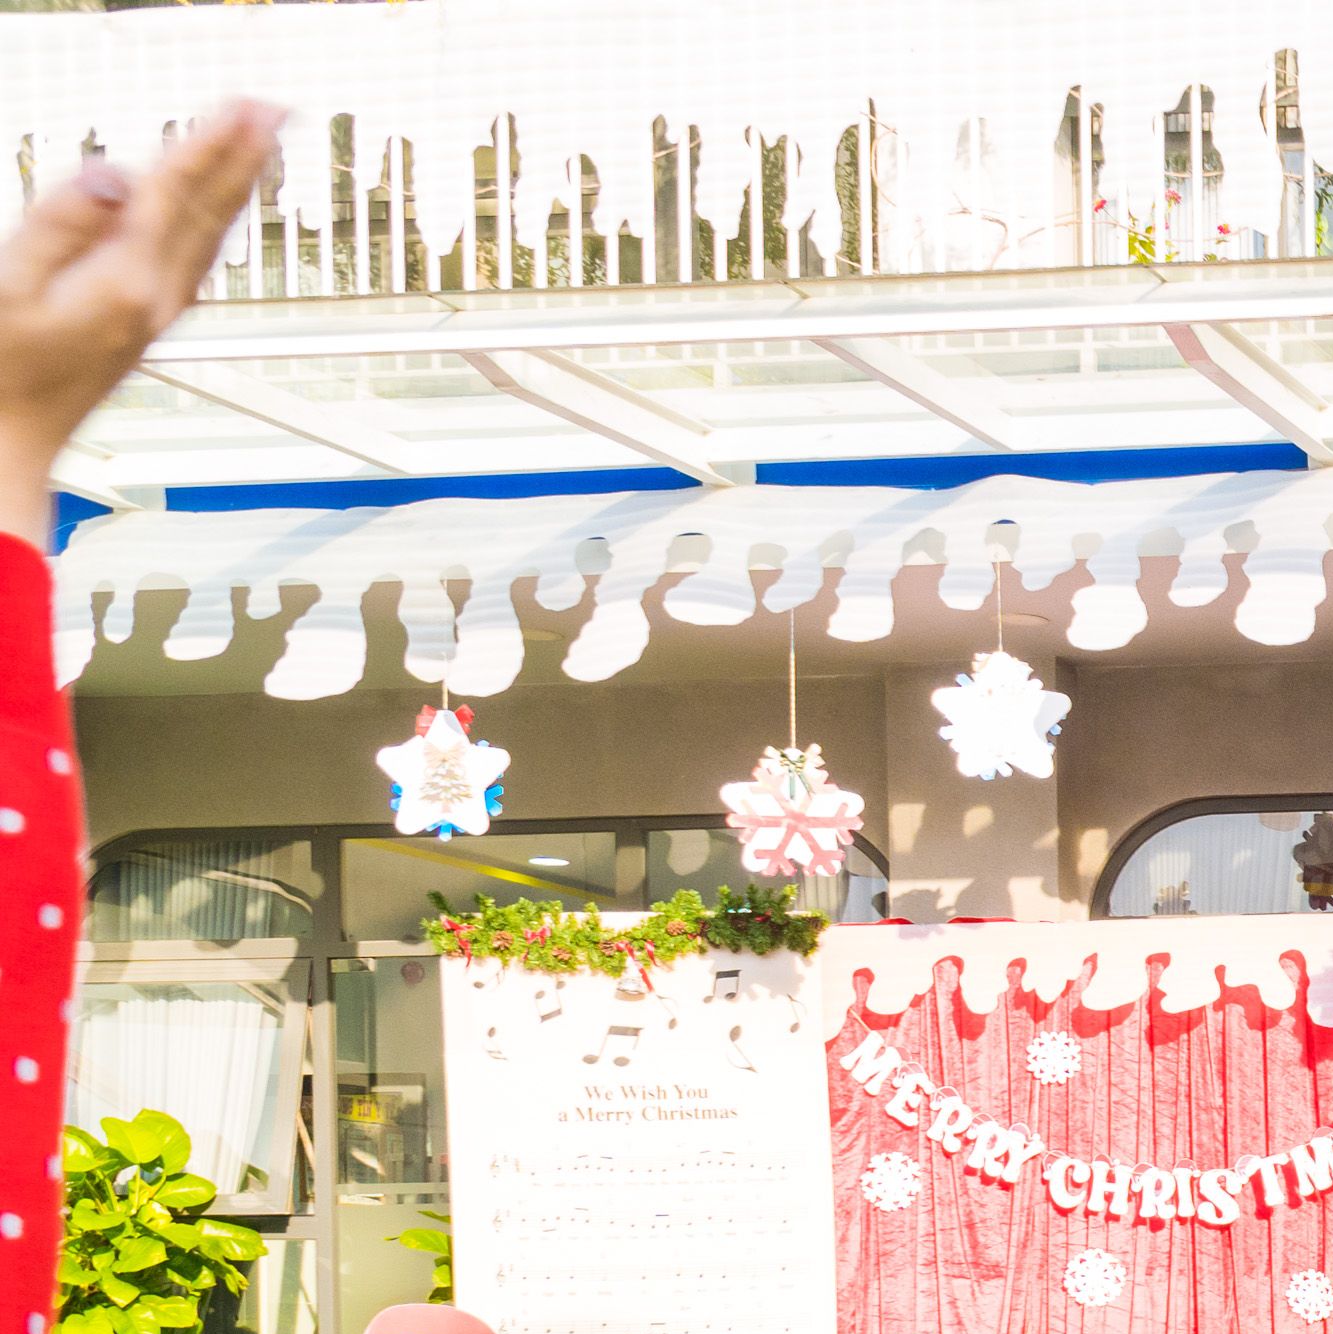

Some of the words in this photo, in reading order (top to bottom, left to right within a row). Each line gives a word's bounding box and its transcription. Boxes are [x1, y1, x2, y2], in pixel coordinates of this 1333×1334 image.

[584, 1085, 614, 1101] We
[620, 1084, 668, 1101] Wish
[673, 1084, 708, 1100] You
[557, 1111, 568, 1122] a
[575, 1107, 634, 1125] Merry
[641, 1105, 739, 1121] Christmas
[840, 1031, 1044, 1184] MERRY
